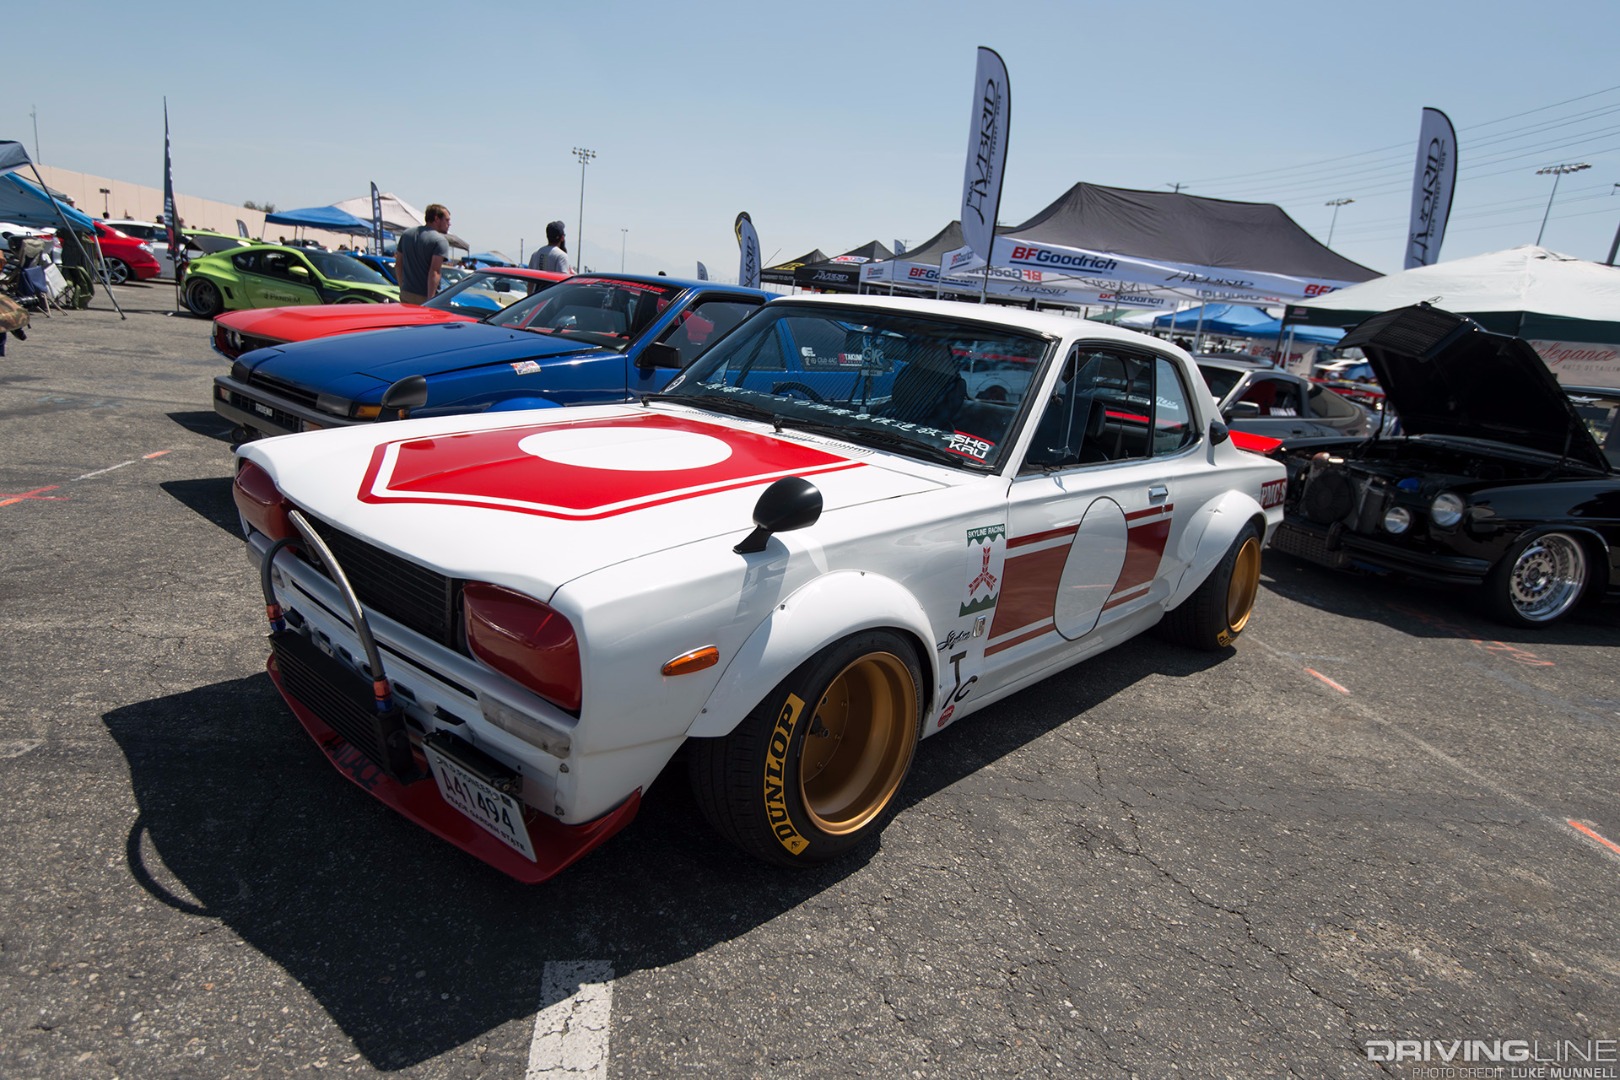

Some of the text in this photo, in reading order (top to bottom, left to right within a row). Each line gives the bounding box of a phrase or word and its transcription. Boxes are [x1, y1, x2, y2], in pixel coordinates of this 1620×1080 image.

[968, 78, 996, 226] HYBRID
[1011, 246, 1118, 271] BFGoodrich
[949, 440, 987, 459] KRU
[953, 433, 990, 450] SHO
[967, 525, 1005, 539] SKYLINE RACING
[765, 702, 798, 842] DUNLOP
